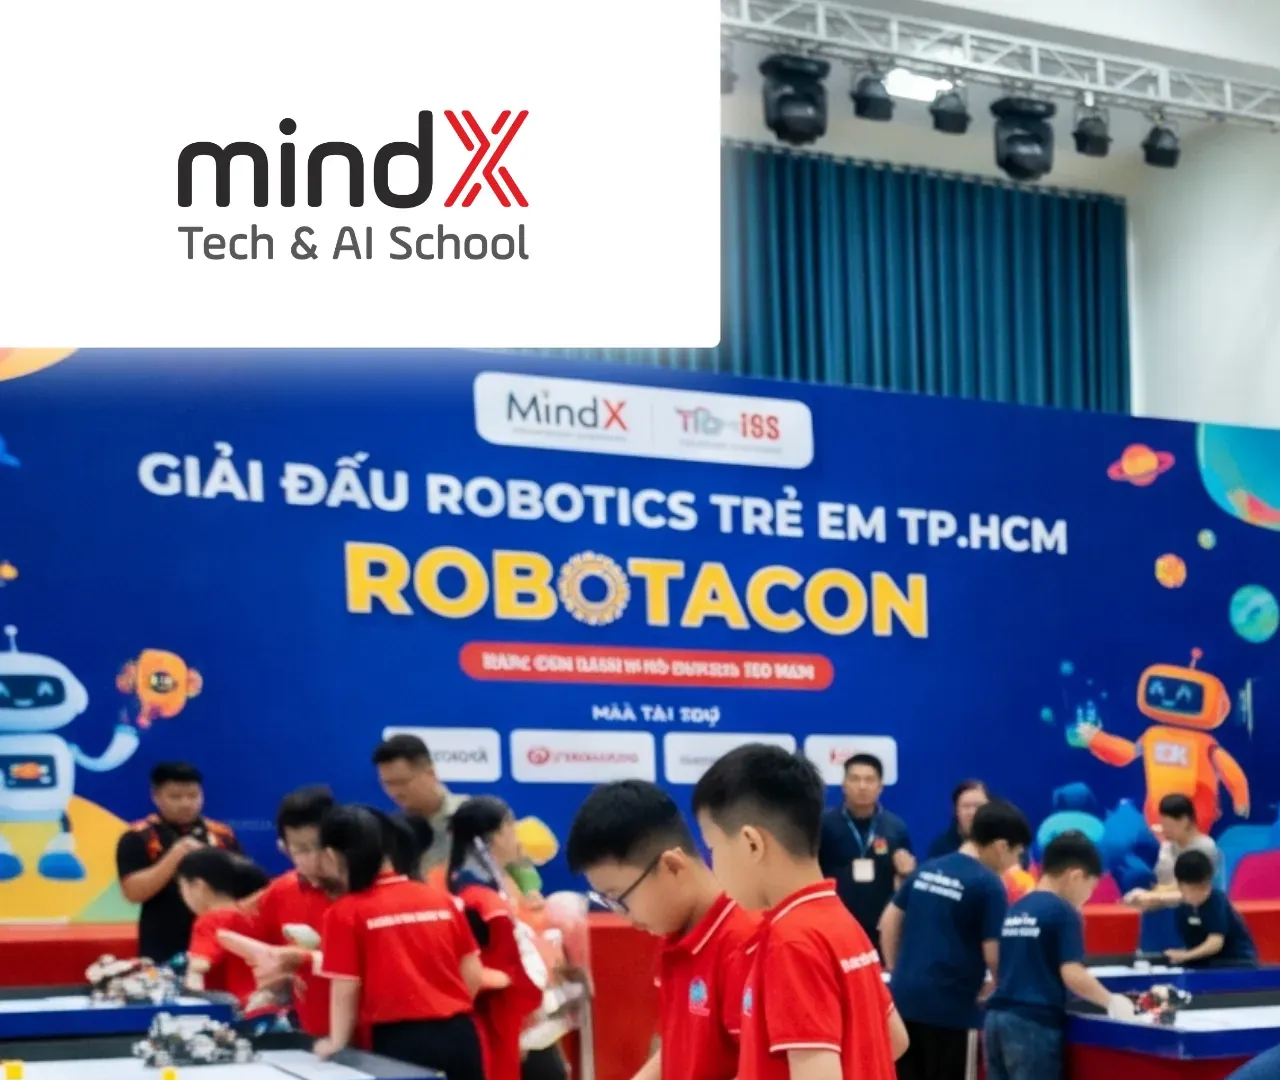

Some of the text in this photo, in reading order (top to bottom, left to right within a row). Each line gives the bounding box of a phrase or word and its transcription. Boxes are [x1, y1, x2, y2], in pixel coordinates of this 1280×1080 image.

[507, 388, 629, 432] MindX
[137, 442, 1068, 555] GIẢI ĐẤU ROBOTICS TRẺ EM TP.HCM
[344, 540, 928, 638] ROBOTACON
